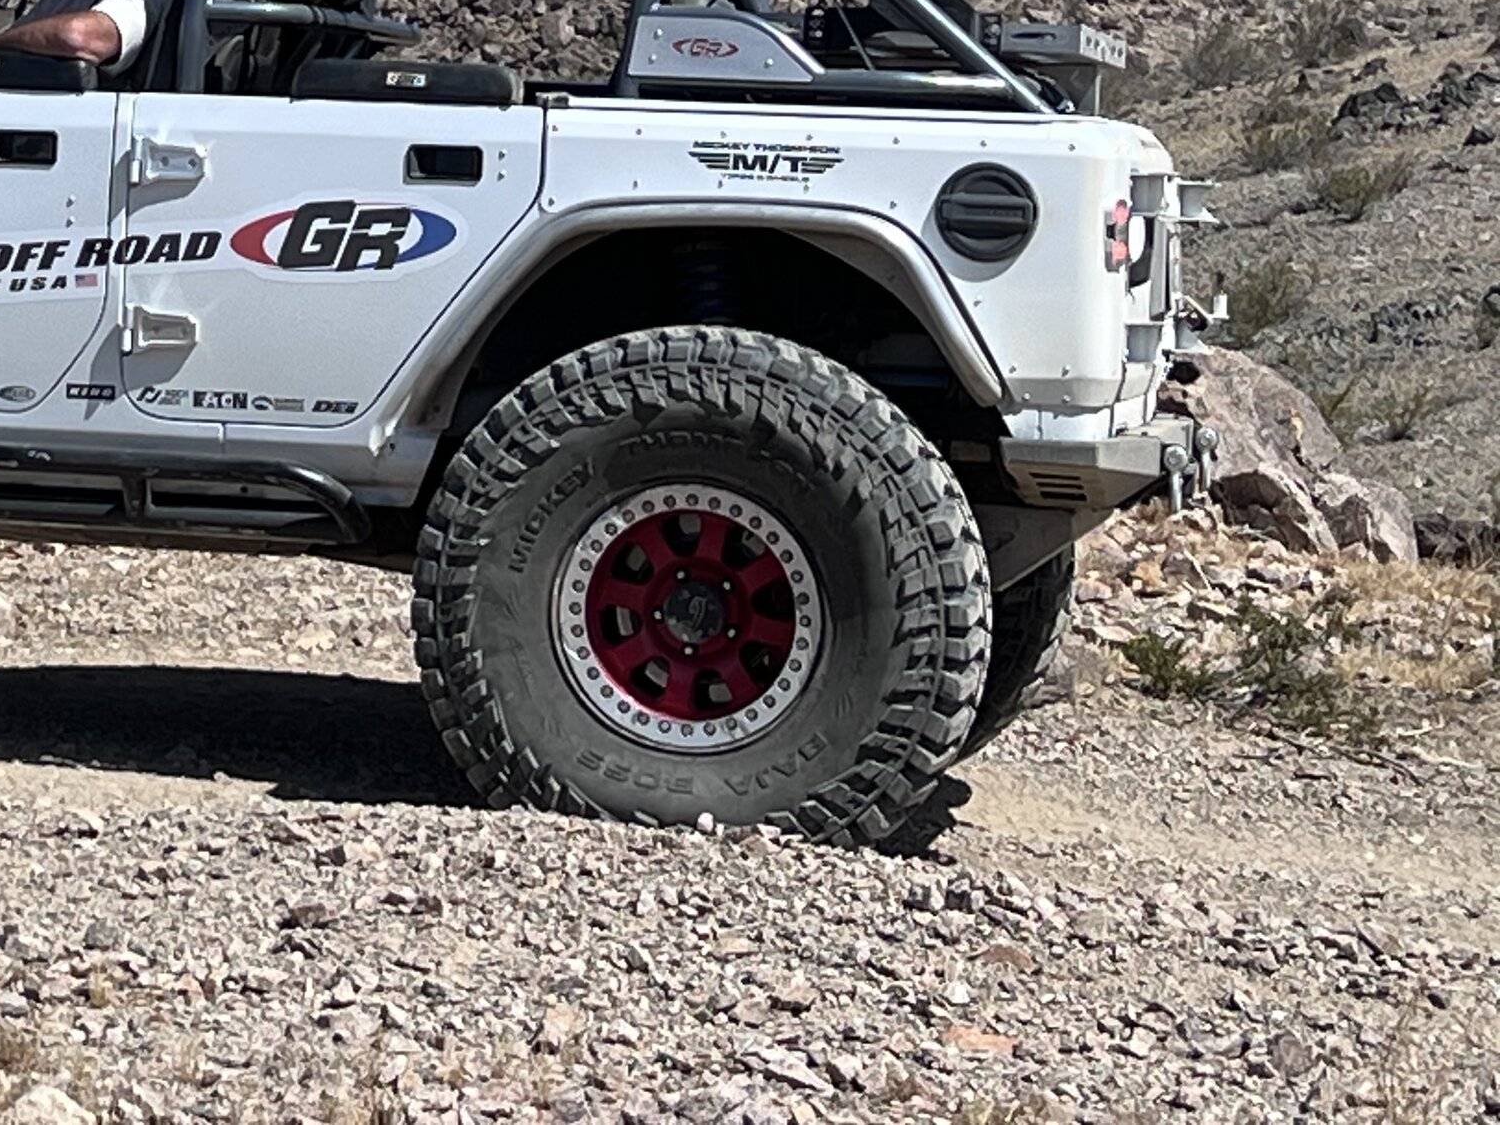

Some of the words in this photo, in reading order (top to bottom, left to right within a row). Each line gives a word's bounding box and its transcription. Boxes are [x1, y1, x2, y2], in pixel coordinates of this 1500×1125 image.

[733, 153, 808, 174] M/T
[74, 231, 223, 268] ROAD
[277, 199, 412, 272] GR
[9, 275, 68, 293] USA
[193, 390, 249, 410] EATON
[506, 455, 597, 575] MICKEY
[721, 730, 830, 798] BAJA
